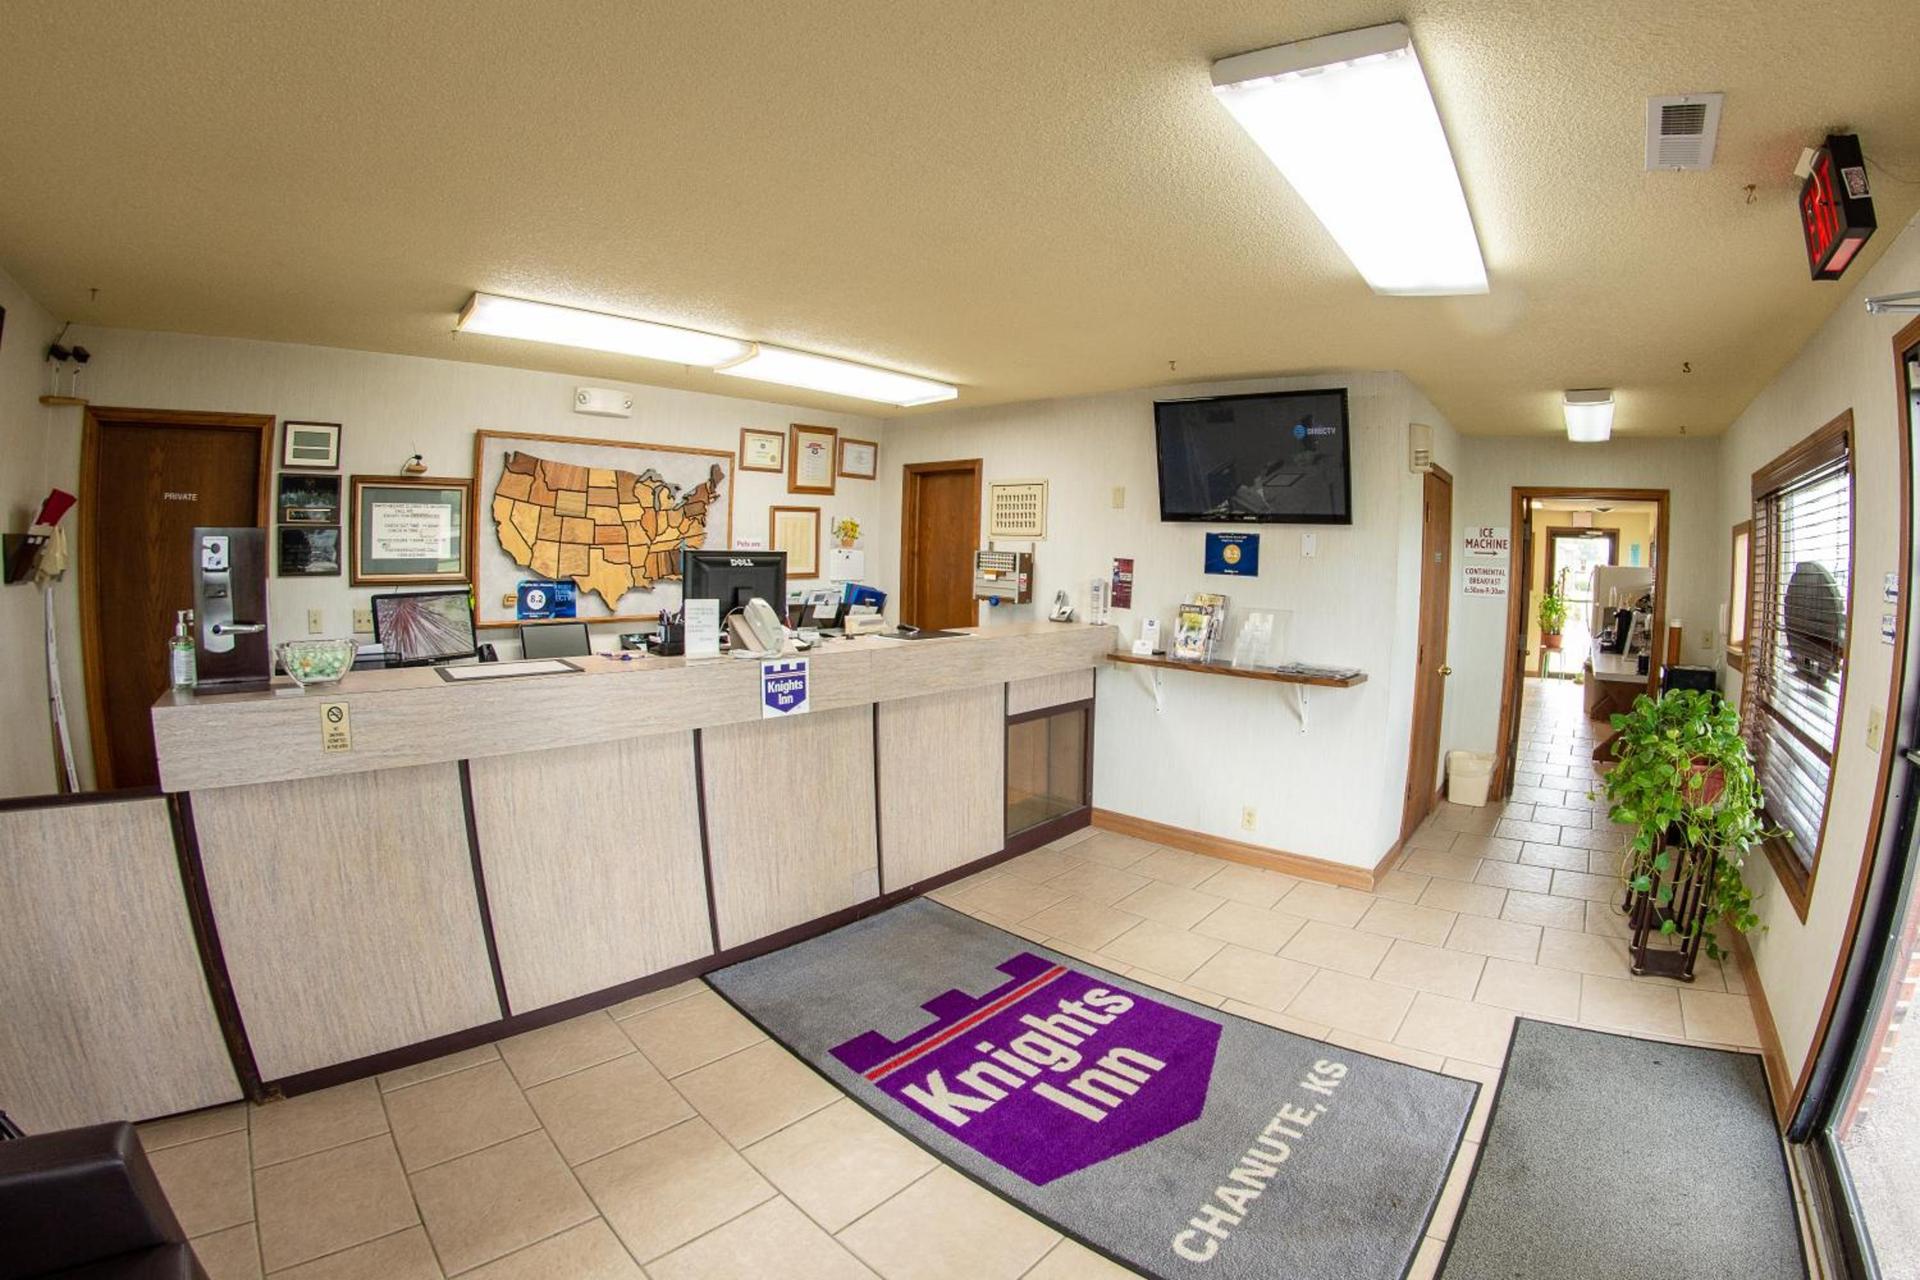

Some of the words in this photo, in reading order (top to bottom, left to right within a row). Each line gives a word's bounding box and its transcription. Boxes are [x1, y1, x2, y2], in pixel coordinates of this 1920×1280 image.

[164, 492, 199, 501] PRIVATE
[1479, 528, 1494, 538] ICE
[1465, 539, 1508, 550] MACHINE
[730, 558, 754, 567] DELL
[1469, 577, 1501, 586] BREAKFAST
[530, 594, 544, 603] 8.2
[767, 680, 804, 693] Knights
[778, 694, 793, 705] Inn
[901, 988, 1135, 1127] Knights
[1032, 1047, 1167, 1123] Inn
[1172, 1102, 1328, 1263] CHANUTE,
[1300, 1059, 1348, 1096] KS
